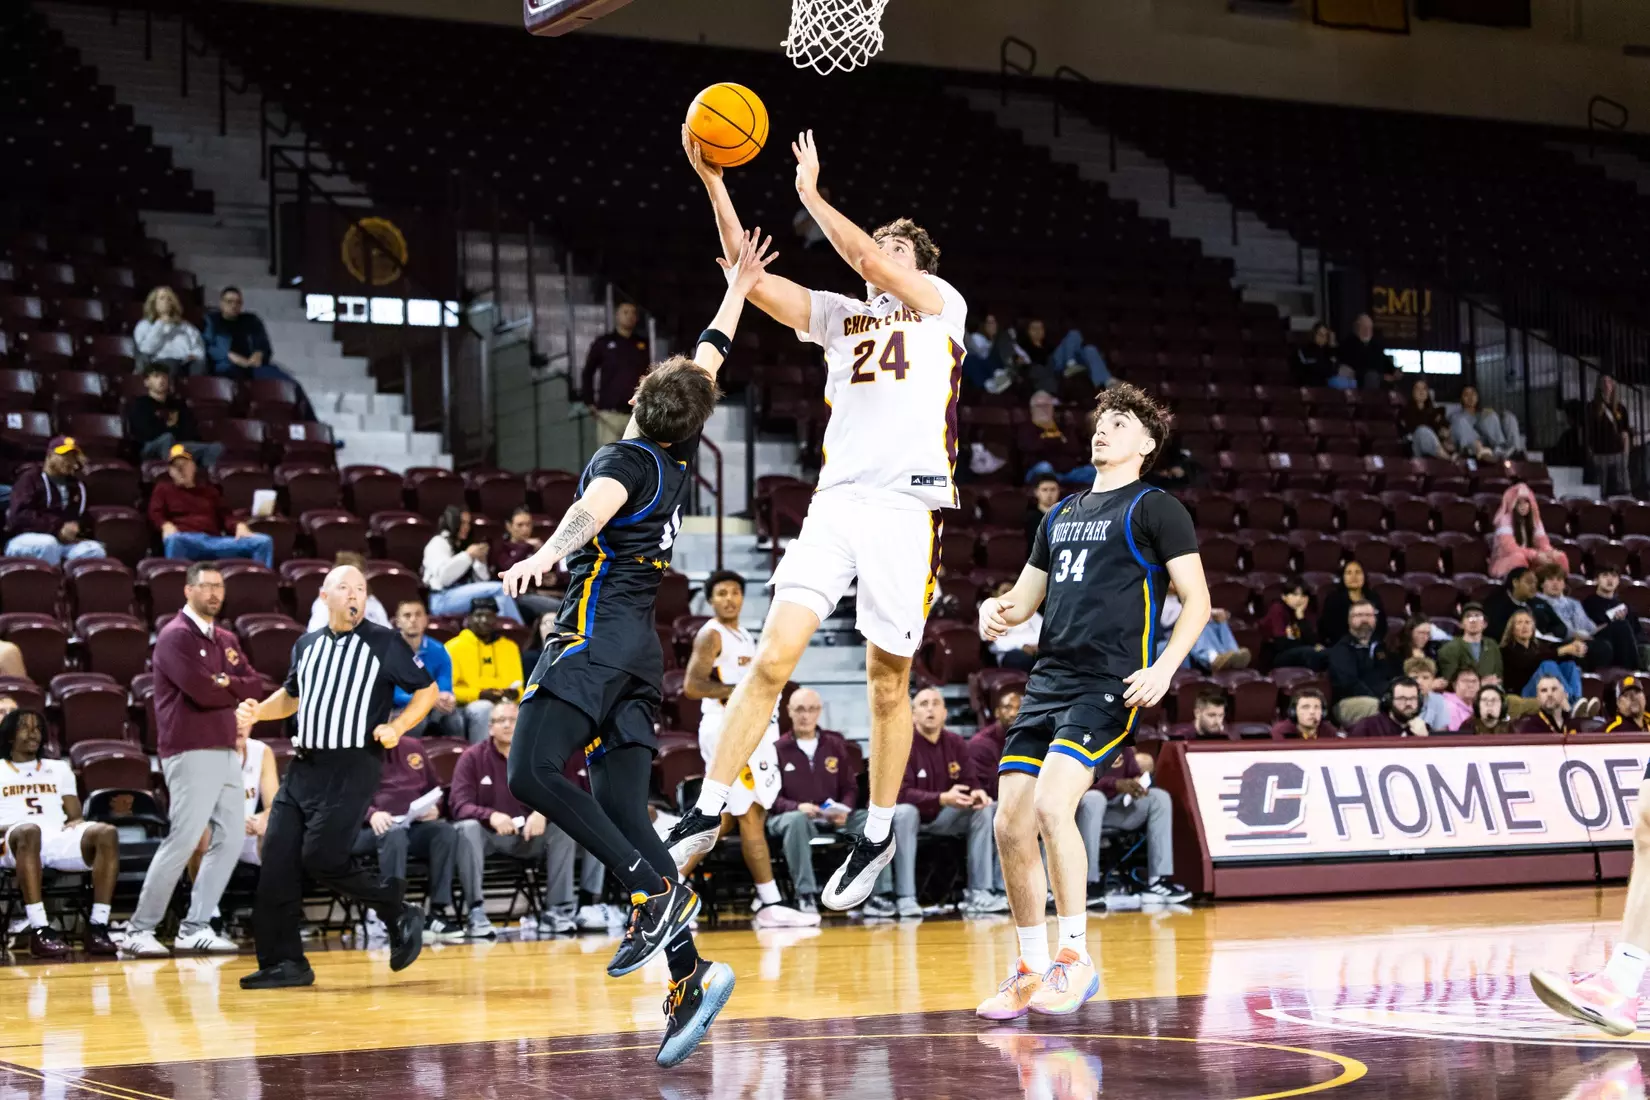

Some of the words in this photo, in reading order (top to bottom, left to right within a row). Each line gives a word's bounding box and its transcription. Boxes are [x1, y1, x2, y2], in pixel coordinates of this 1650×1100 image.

[850, 330, 910, 385] 24
[1051, 521, 1084, 544] NORTH
[1081, 520, 1112, 541] PARK
[1054, 548, 1088, 583] 34
[2, 784, 57, 797] CHIPPEWAS
[1320, 759, 1546, 837] HOME
[1558, 758, 1641, 830] OF
[24, 797, 43, 815] 5
